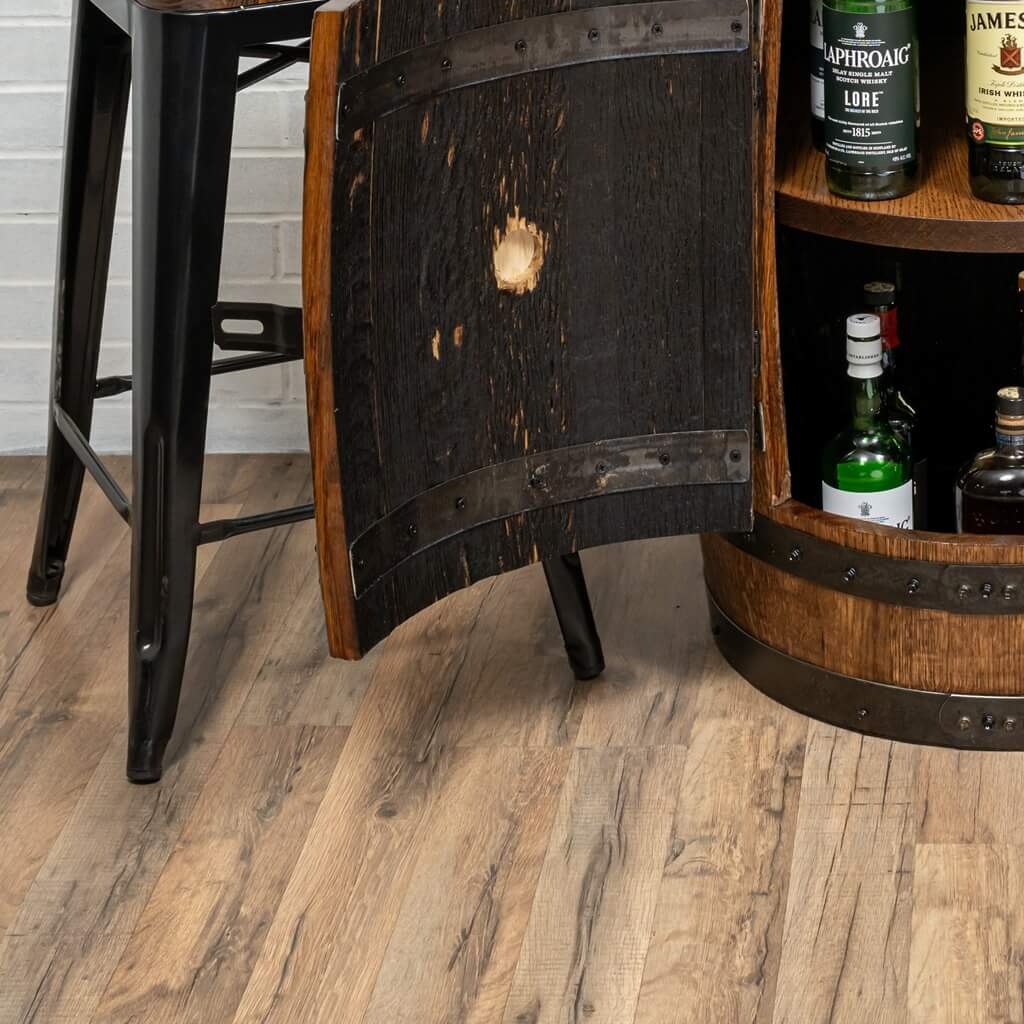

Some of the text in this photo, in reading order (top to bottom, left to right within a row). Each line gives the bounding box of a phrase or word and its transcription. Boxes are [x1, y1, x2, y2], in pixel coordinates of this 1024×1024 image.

[824, 42, 910, 68] LAPHROAIG
[848, 70, 873, 78] SINGLE
[836, 76, 859, 84] SCOTCH
[978, 87, 1001, 96] IRISH
[844, 90, 880, 107] LORE
[851, 127, 871, 137] 1815
